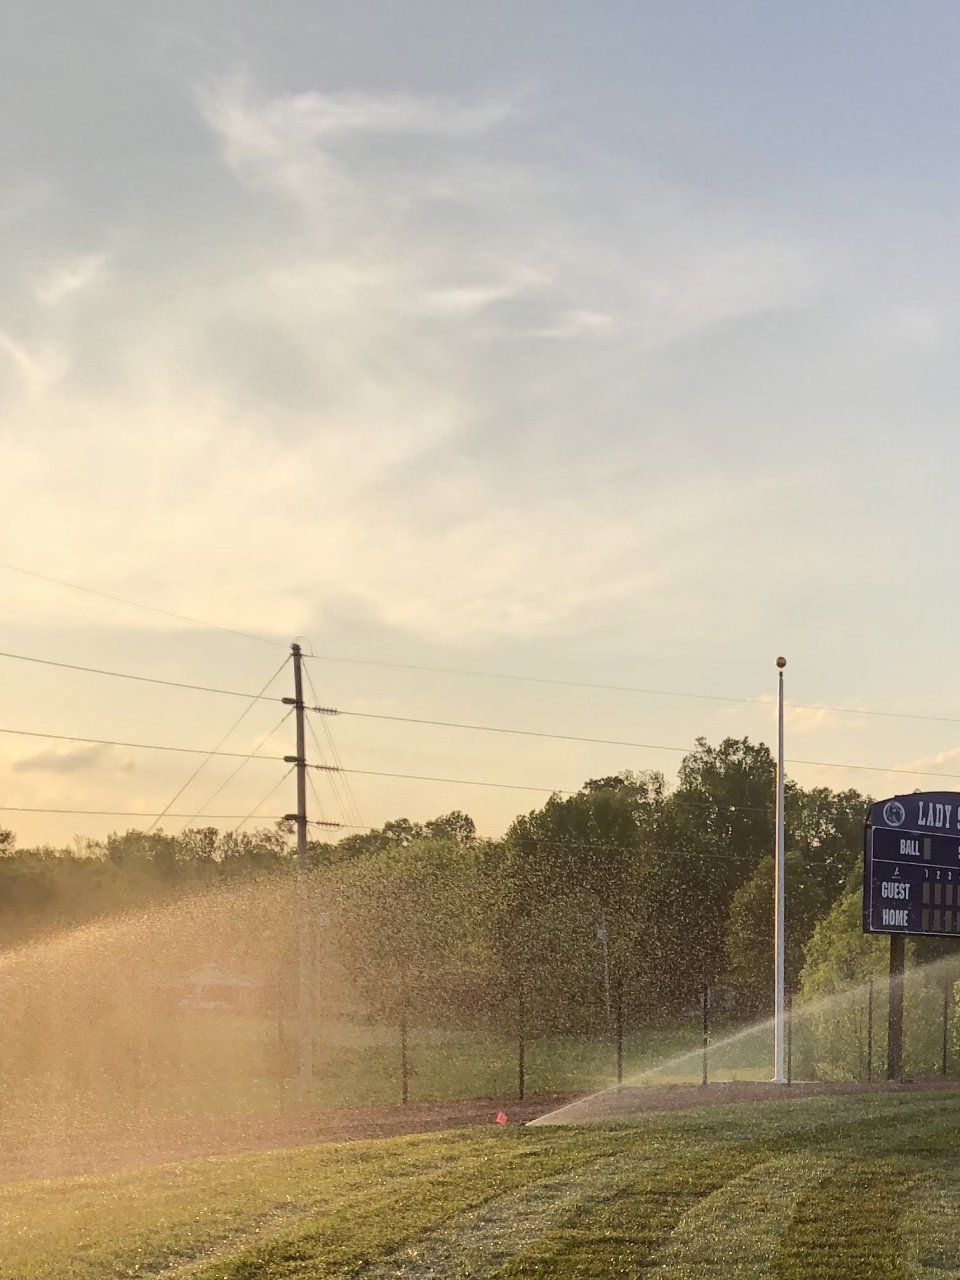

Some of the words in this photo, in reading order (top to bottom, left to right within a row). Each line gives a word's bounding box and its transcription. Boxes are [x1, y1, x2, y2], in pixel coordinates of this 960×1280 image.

[918, 801, 951, 828] LADY
[900, 839, 920, 856] BALL
[924, 869, 929, 878] 1
[936, 870, 941, 880] 2
[947, 871, 952, 880] 3
[881, 881, 910, 900] GUEST
[882, 909, 908, 926] HOME
